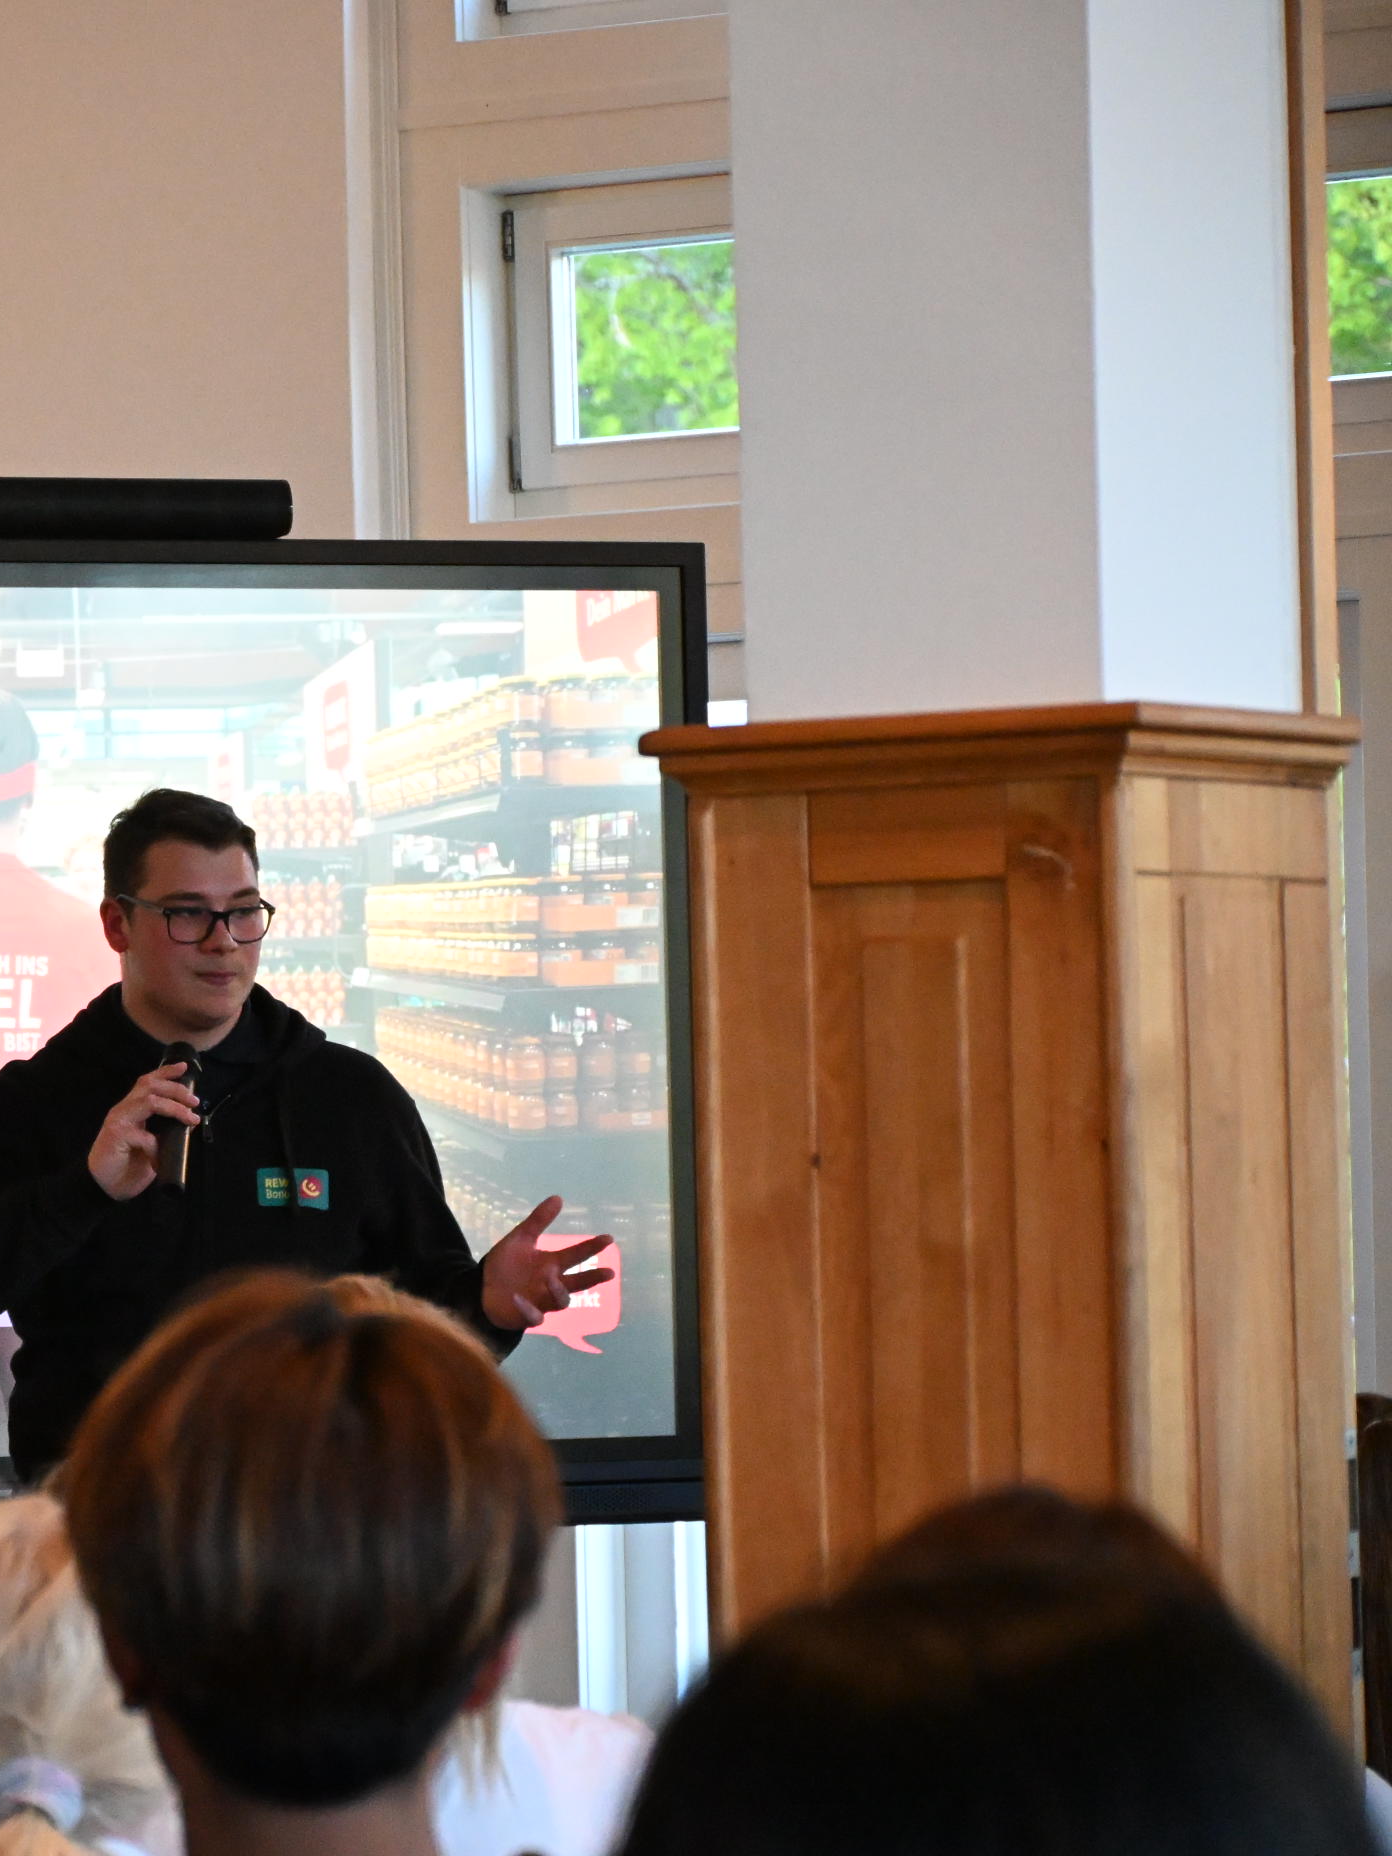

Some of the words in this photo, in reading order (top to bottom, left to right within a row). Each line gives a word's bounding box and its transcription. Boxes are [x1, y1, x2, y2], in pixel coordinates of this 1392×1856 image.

[15, 955, 49, 976] INS
[4, 1032, 41, 1053] BIST
[264, 1177, 289, 1188] REW
[568, 1289, 601, 1309] arkt
